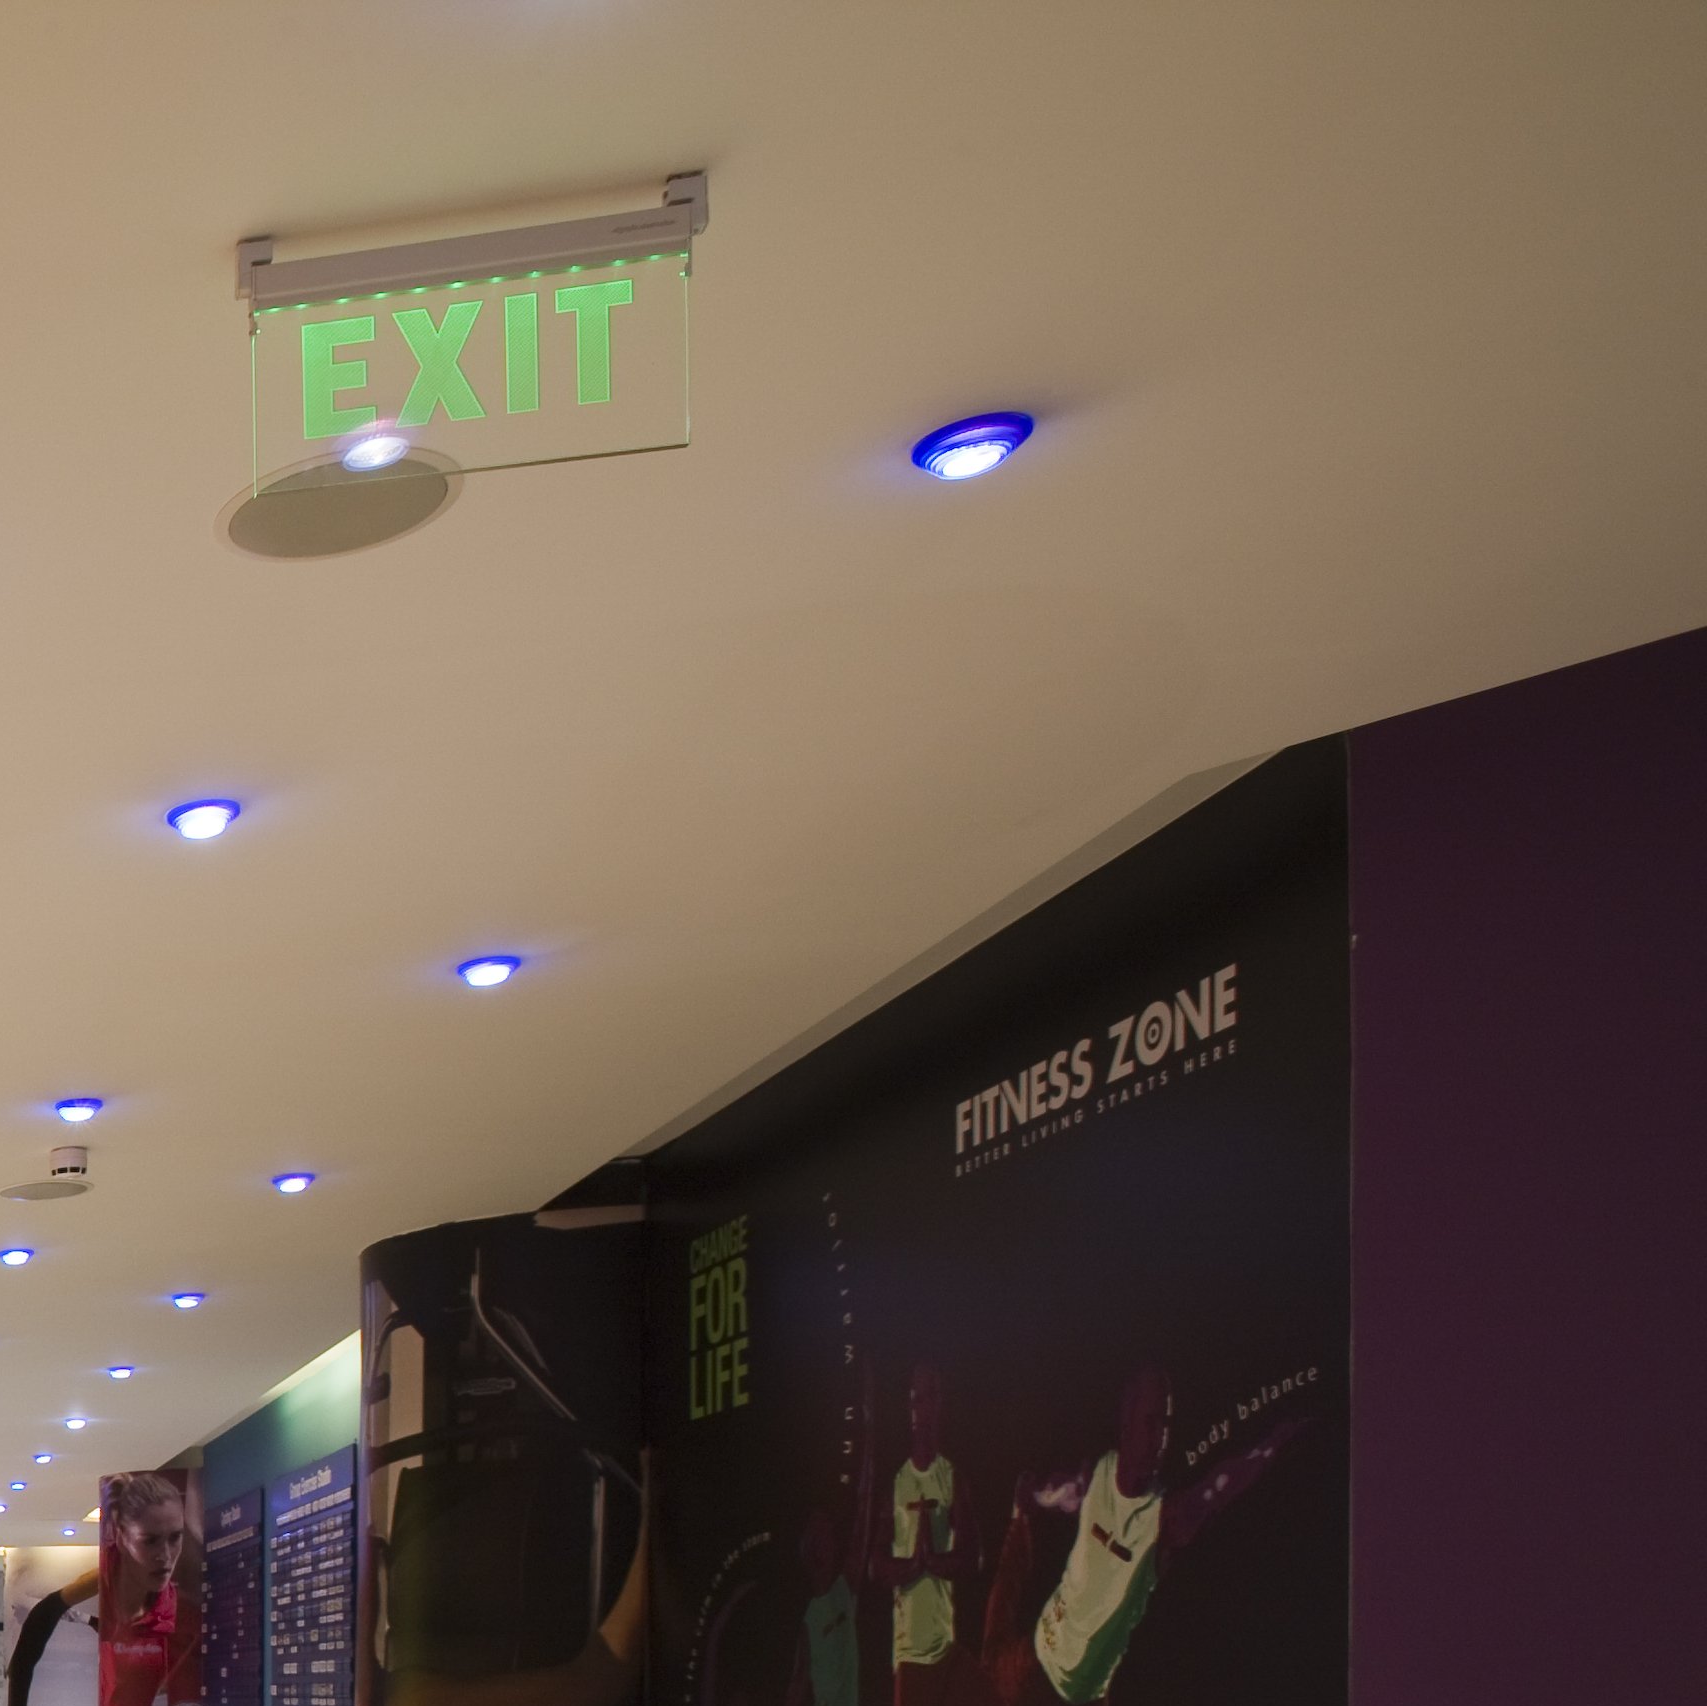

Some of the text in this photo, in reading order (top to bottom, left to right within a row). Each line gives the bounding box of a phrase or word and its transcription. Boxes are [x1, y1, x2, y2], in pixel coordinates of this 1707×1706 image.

[301, 279, 634, 440] EXIT
[954, 962, 1238, 1155] FITNESS ZONE
[954, 1039, 1238, 1178] BETTER LIVING STARTS HERE
[689, 1212, 750, 1274] CHANGE
[689, 1256, 749, 1352] FOR
[689, 1337, 750, 1421] LIFE
[1184, 1363, 1319, 1466] body balance
